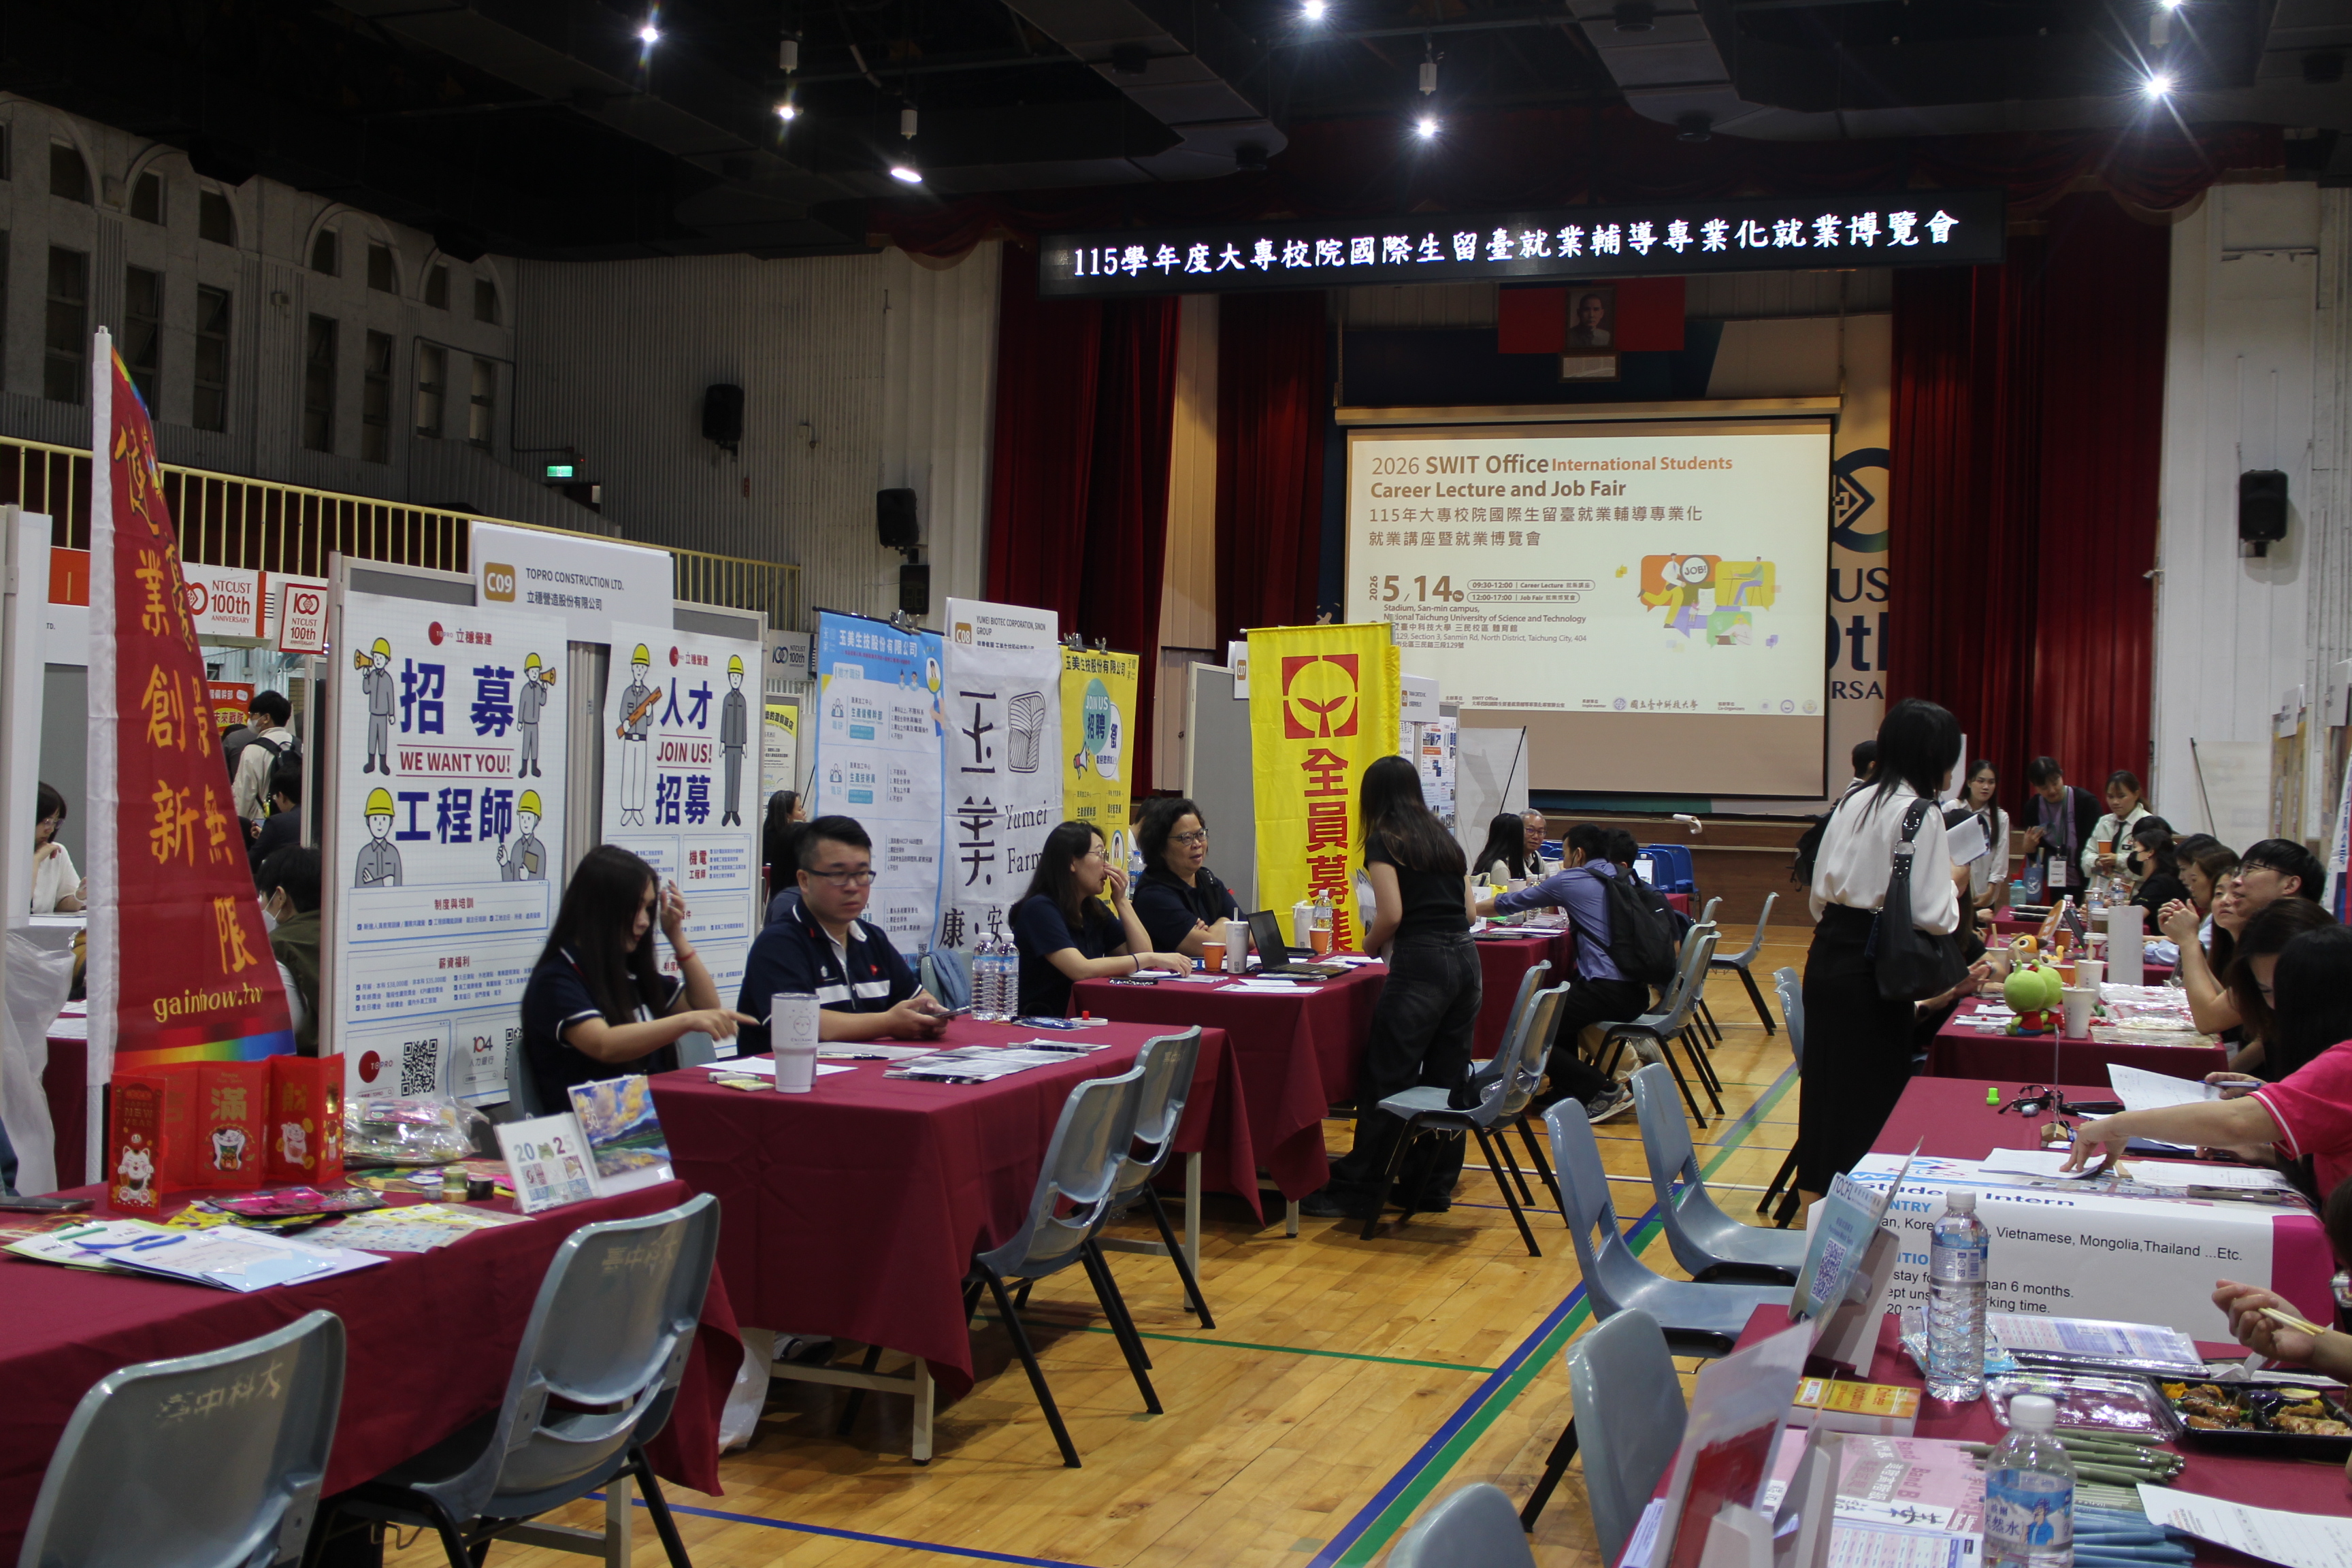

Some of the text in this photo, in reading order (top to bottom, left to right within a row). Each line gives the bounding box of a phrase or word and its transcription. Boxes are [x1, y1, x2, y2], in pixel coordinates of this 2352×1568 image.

[1075, 210, 1960, 277] 115學年度大專校院國際生留臺就業輔導專業化就業博覽會
[1372, 453, 1733, 475] 2026 SWIT Office International Students
[1371, 479, 1627, 498] Career Lecture and Job Fair
[1369, 506, 1702, 523] 115年大專校院國際生留臺就業輔導專業化
[1369, 530, 1541, 546] 就業講座暨就業博覽會
[1684, 561, 1707, 576] JOB!
[212, 579, 252, 594] NTCUST
[486, 572, 513, 593] C09
[525, 567, 625, 591] TOPRO CONSTRUCTION LTD.
[1369, 576, 1378, 601] 2026
[211, 594, 250, 615] 100th
[527, 590, 602, 611] 立穩營造股份有限公司
[1384, 604, 1416, 612] Stadium,
[1449, 605, 1480, 614] campus,
[211, 615, 250, 624] ANNIVERSARY
[291, 617, 318, 627] NTCUST
[976, 615, 1046, 631] YUMEI BIOTEC CORPORATION, SINON
[1415, 614, 1448, 622] Taichung
[1450, 615, 1488, 623] University
[1543, 615, 1586, 624] Technology
[1455, 624, 1489, 632] 三民校區
[290, 627, 316, 640] 100th
[956, 629, 971, 644] C08
[976, 626, 992, 636] GROUP
[1528, 634, 1557, 643] Taichung
[838, 629, 917, 657] 玉美生技股份有限公司
[789, 652, 804, 664] 100th
[1066, 655, 1126, 677] 玉美生技股份有限公司
[1237, 664, 1246, 676] C07
[399, 657, 514, 738] 招募
[1832, 680, 1885, 700] RSA
[659, 676, 713, 730] 人才
[1085, 693, 1109, 710] JOIN US
[1087, 712, 1106, 740] 招聘
[399, 751, 511, 773] WE WANT YOU!
[656, 741, 713, 764] JOIN US!
[655, 773, 711, 825] 招募
[395, 786, 513, 845] 工程師
[1004, 800, 1048, 831] Yumei
[689, 849, 707, 866] 機電
[689, 869, 706, 880] 工程師
[434, 897, 474, 911] 制度與培訓
[438, 956, 470, 970] 薪資福利
[472, 1034, 493, 1054] 104
[370, 1060, 393, 1070] TOPRO
[468, 1056, 495, 1068] 人力銀行
[210, 1087, 247, 1122] 滿
[1833, 1175, 1854, 1200] TOCFL
[1986, 1192, 2075, 1207] Intern
[1905, 1218, 1935, 1231] Kore
[1996, 1226, 2076, 1246] Vietnamese,
[1893, 1271, 2074, 1298] stay 6 months.
[1888, 1287, 2051, 1314] ept rking time.
[1897, 1466, 1931, 1499] Band B
